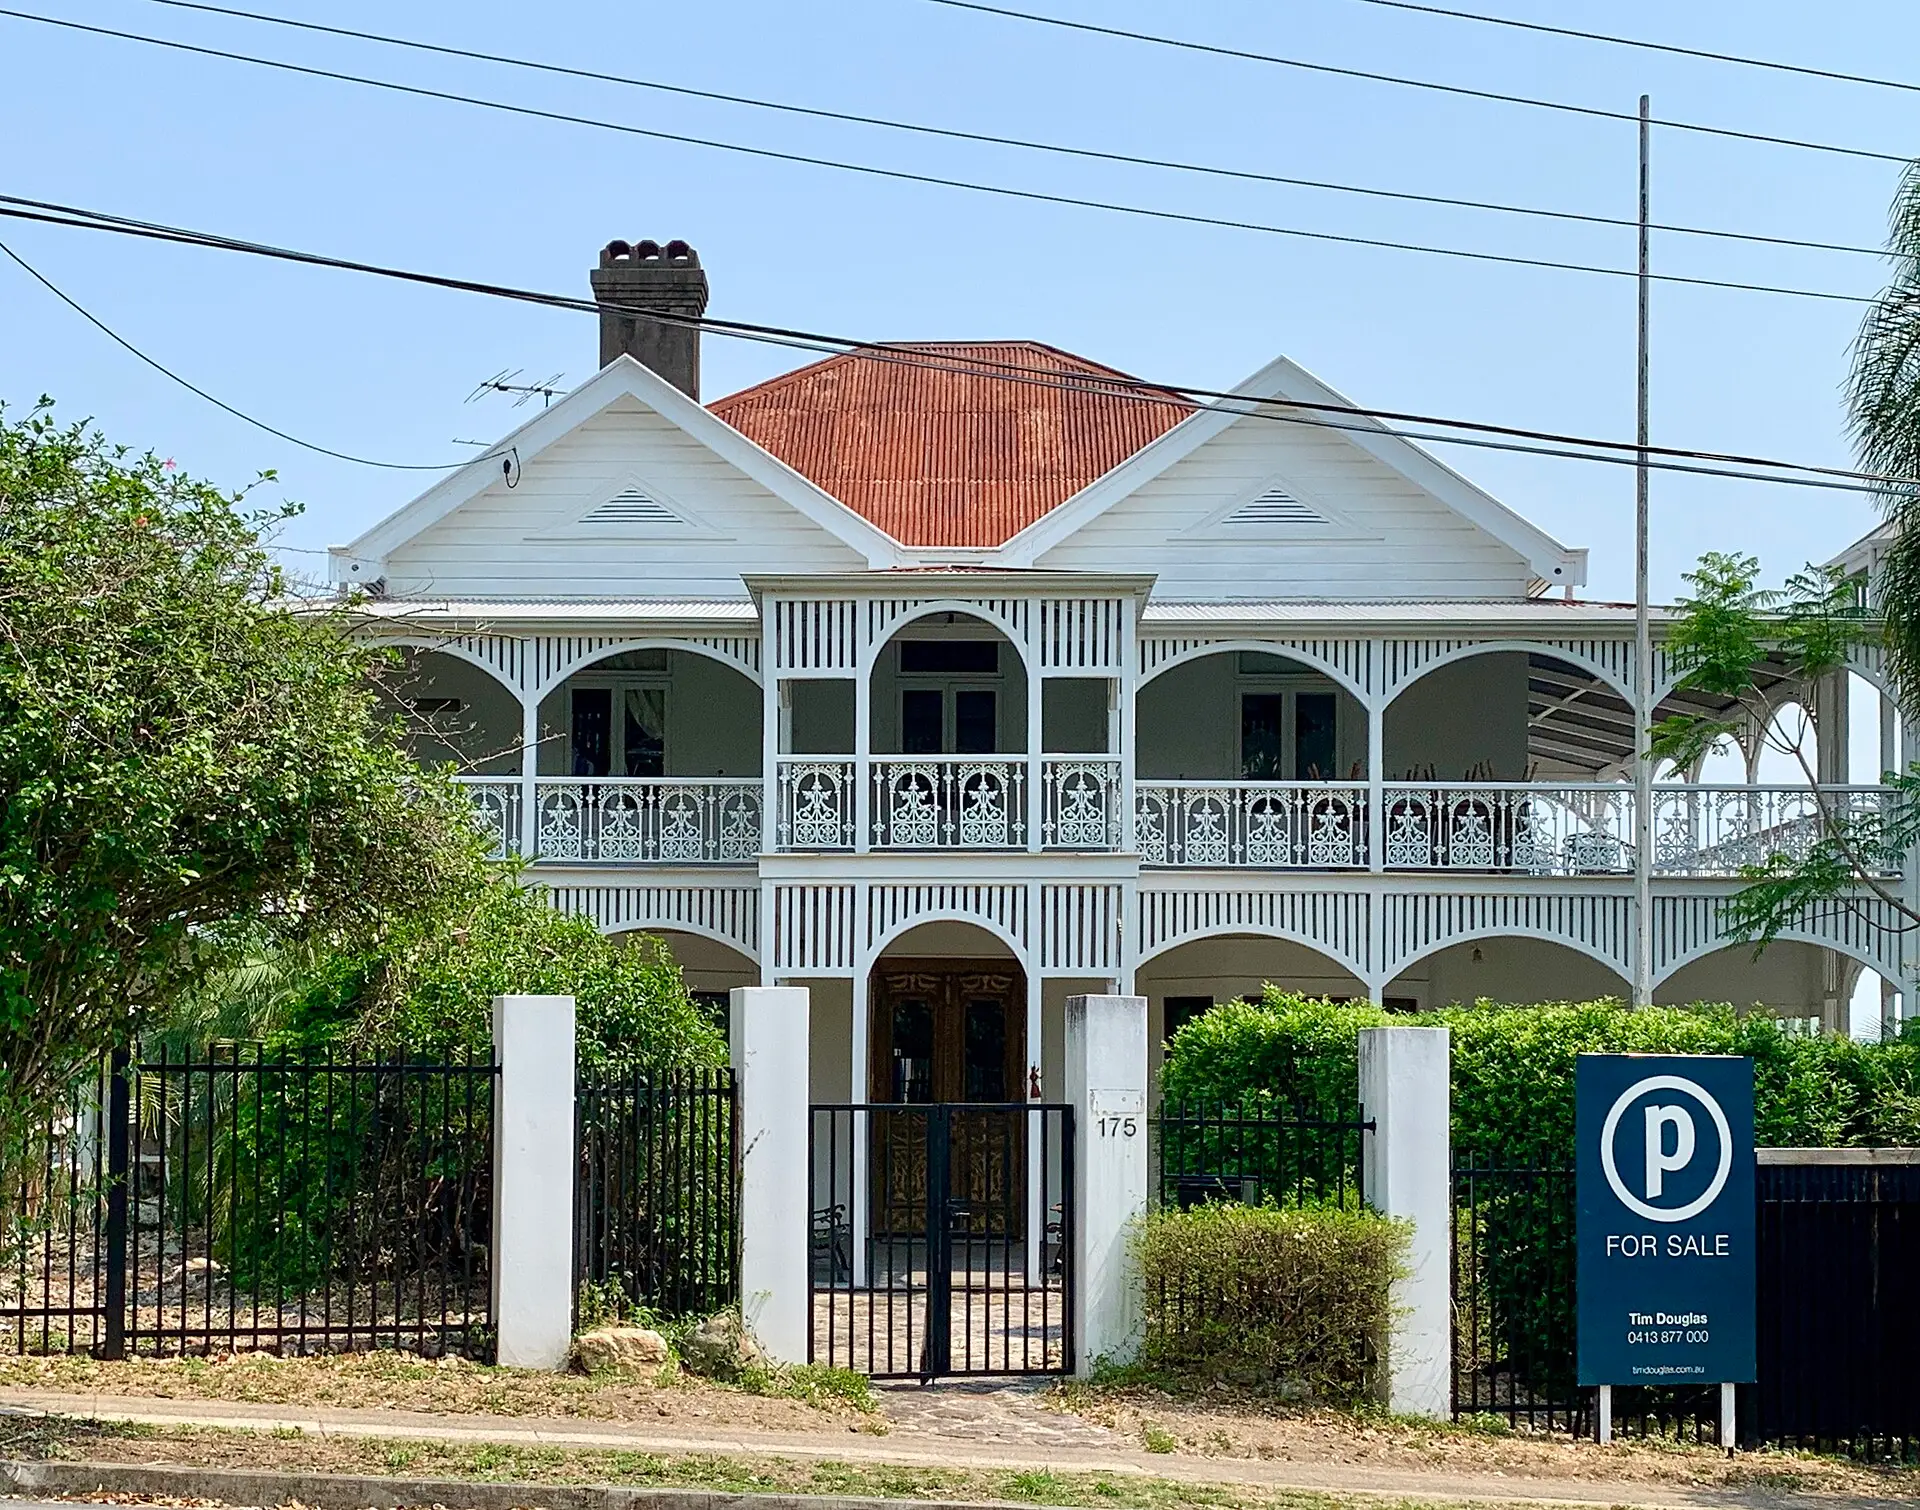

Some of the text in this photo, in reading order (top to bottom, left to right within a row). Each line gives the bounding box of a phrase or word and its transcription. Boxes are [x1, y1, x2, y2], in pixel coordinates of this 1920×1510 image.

[1098, 1117, 1137, 1137] 175
[1606, 1234, 1729, 1257] FOR SALE
[1629, 1312, 1708, 1327] Tim Douglas
[1628, 1330, 1709, 1343] 0413 877 000
[1632, 1365, 1705, 1375] timdouglas.com.au
